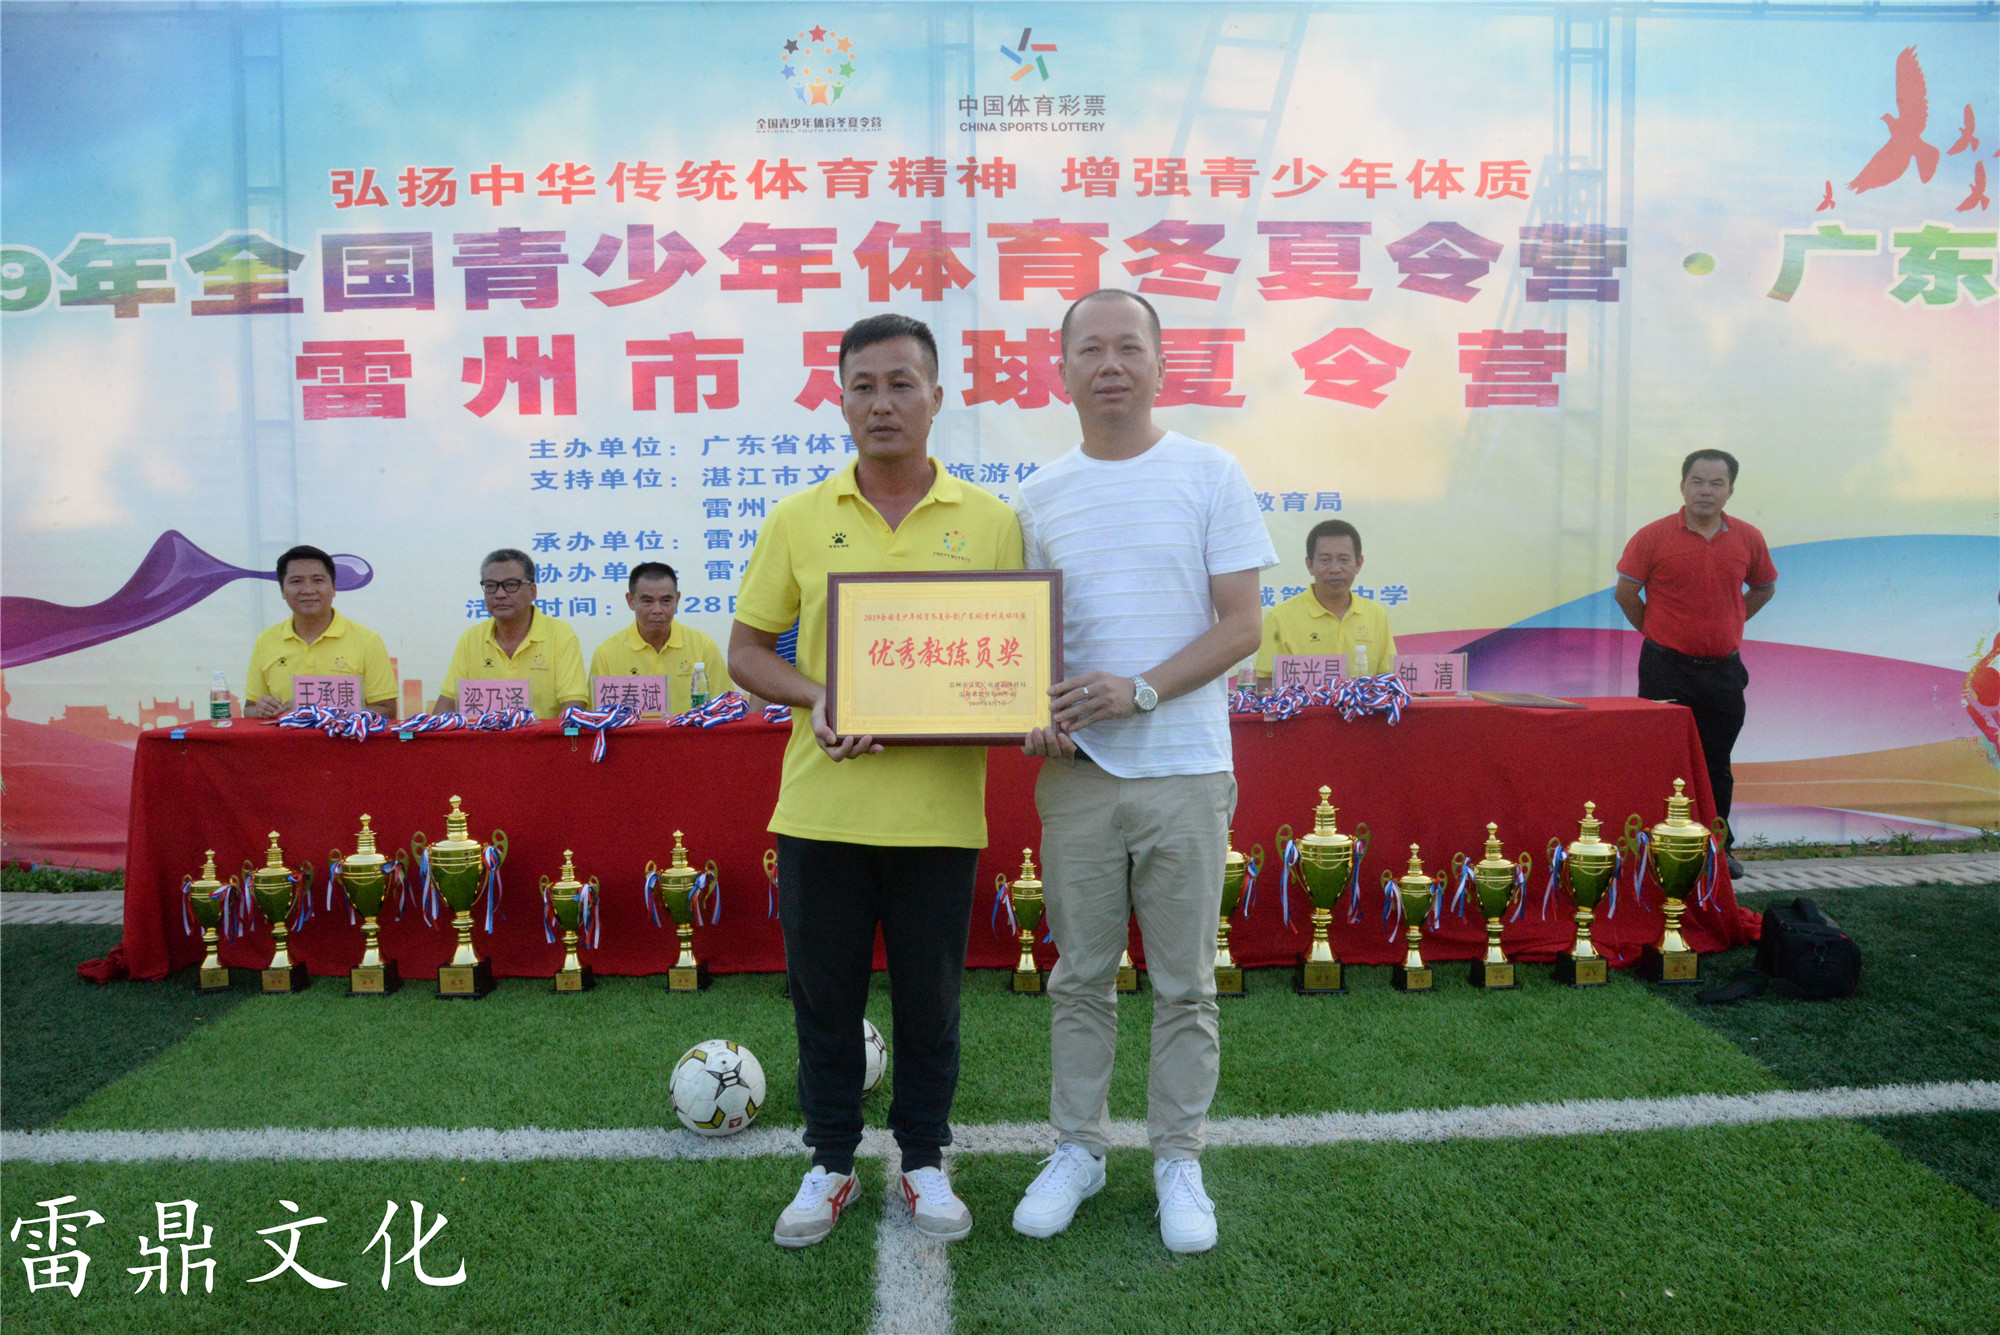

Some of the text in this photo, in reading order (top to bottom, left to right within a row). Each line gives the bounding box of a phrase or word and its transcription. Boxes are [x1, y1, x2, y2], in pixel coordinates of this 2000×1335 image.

[958, 94, 1106, 117] 中国体育彩票
[756, 117, 882, 129] 全国青少年体育冬夏令营
[959, 122, 1105, 132] CHINA SPORTS LOTTERY
[330, 157, 1532, 209] 弘扬中华传统体育精神 增强青少年体质
[868, 636, 1024, 670] 优秀教练员奖
[298, 680, 355, 708] 王承康
[464, 687, 525, 715] 梁乃泽
[600, 683, 662, 711] 符春斌
